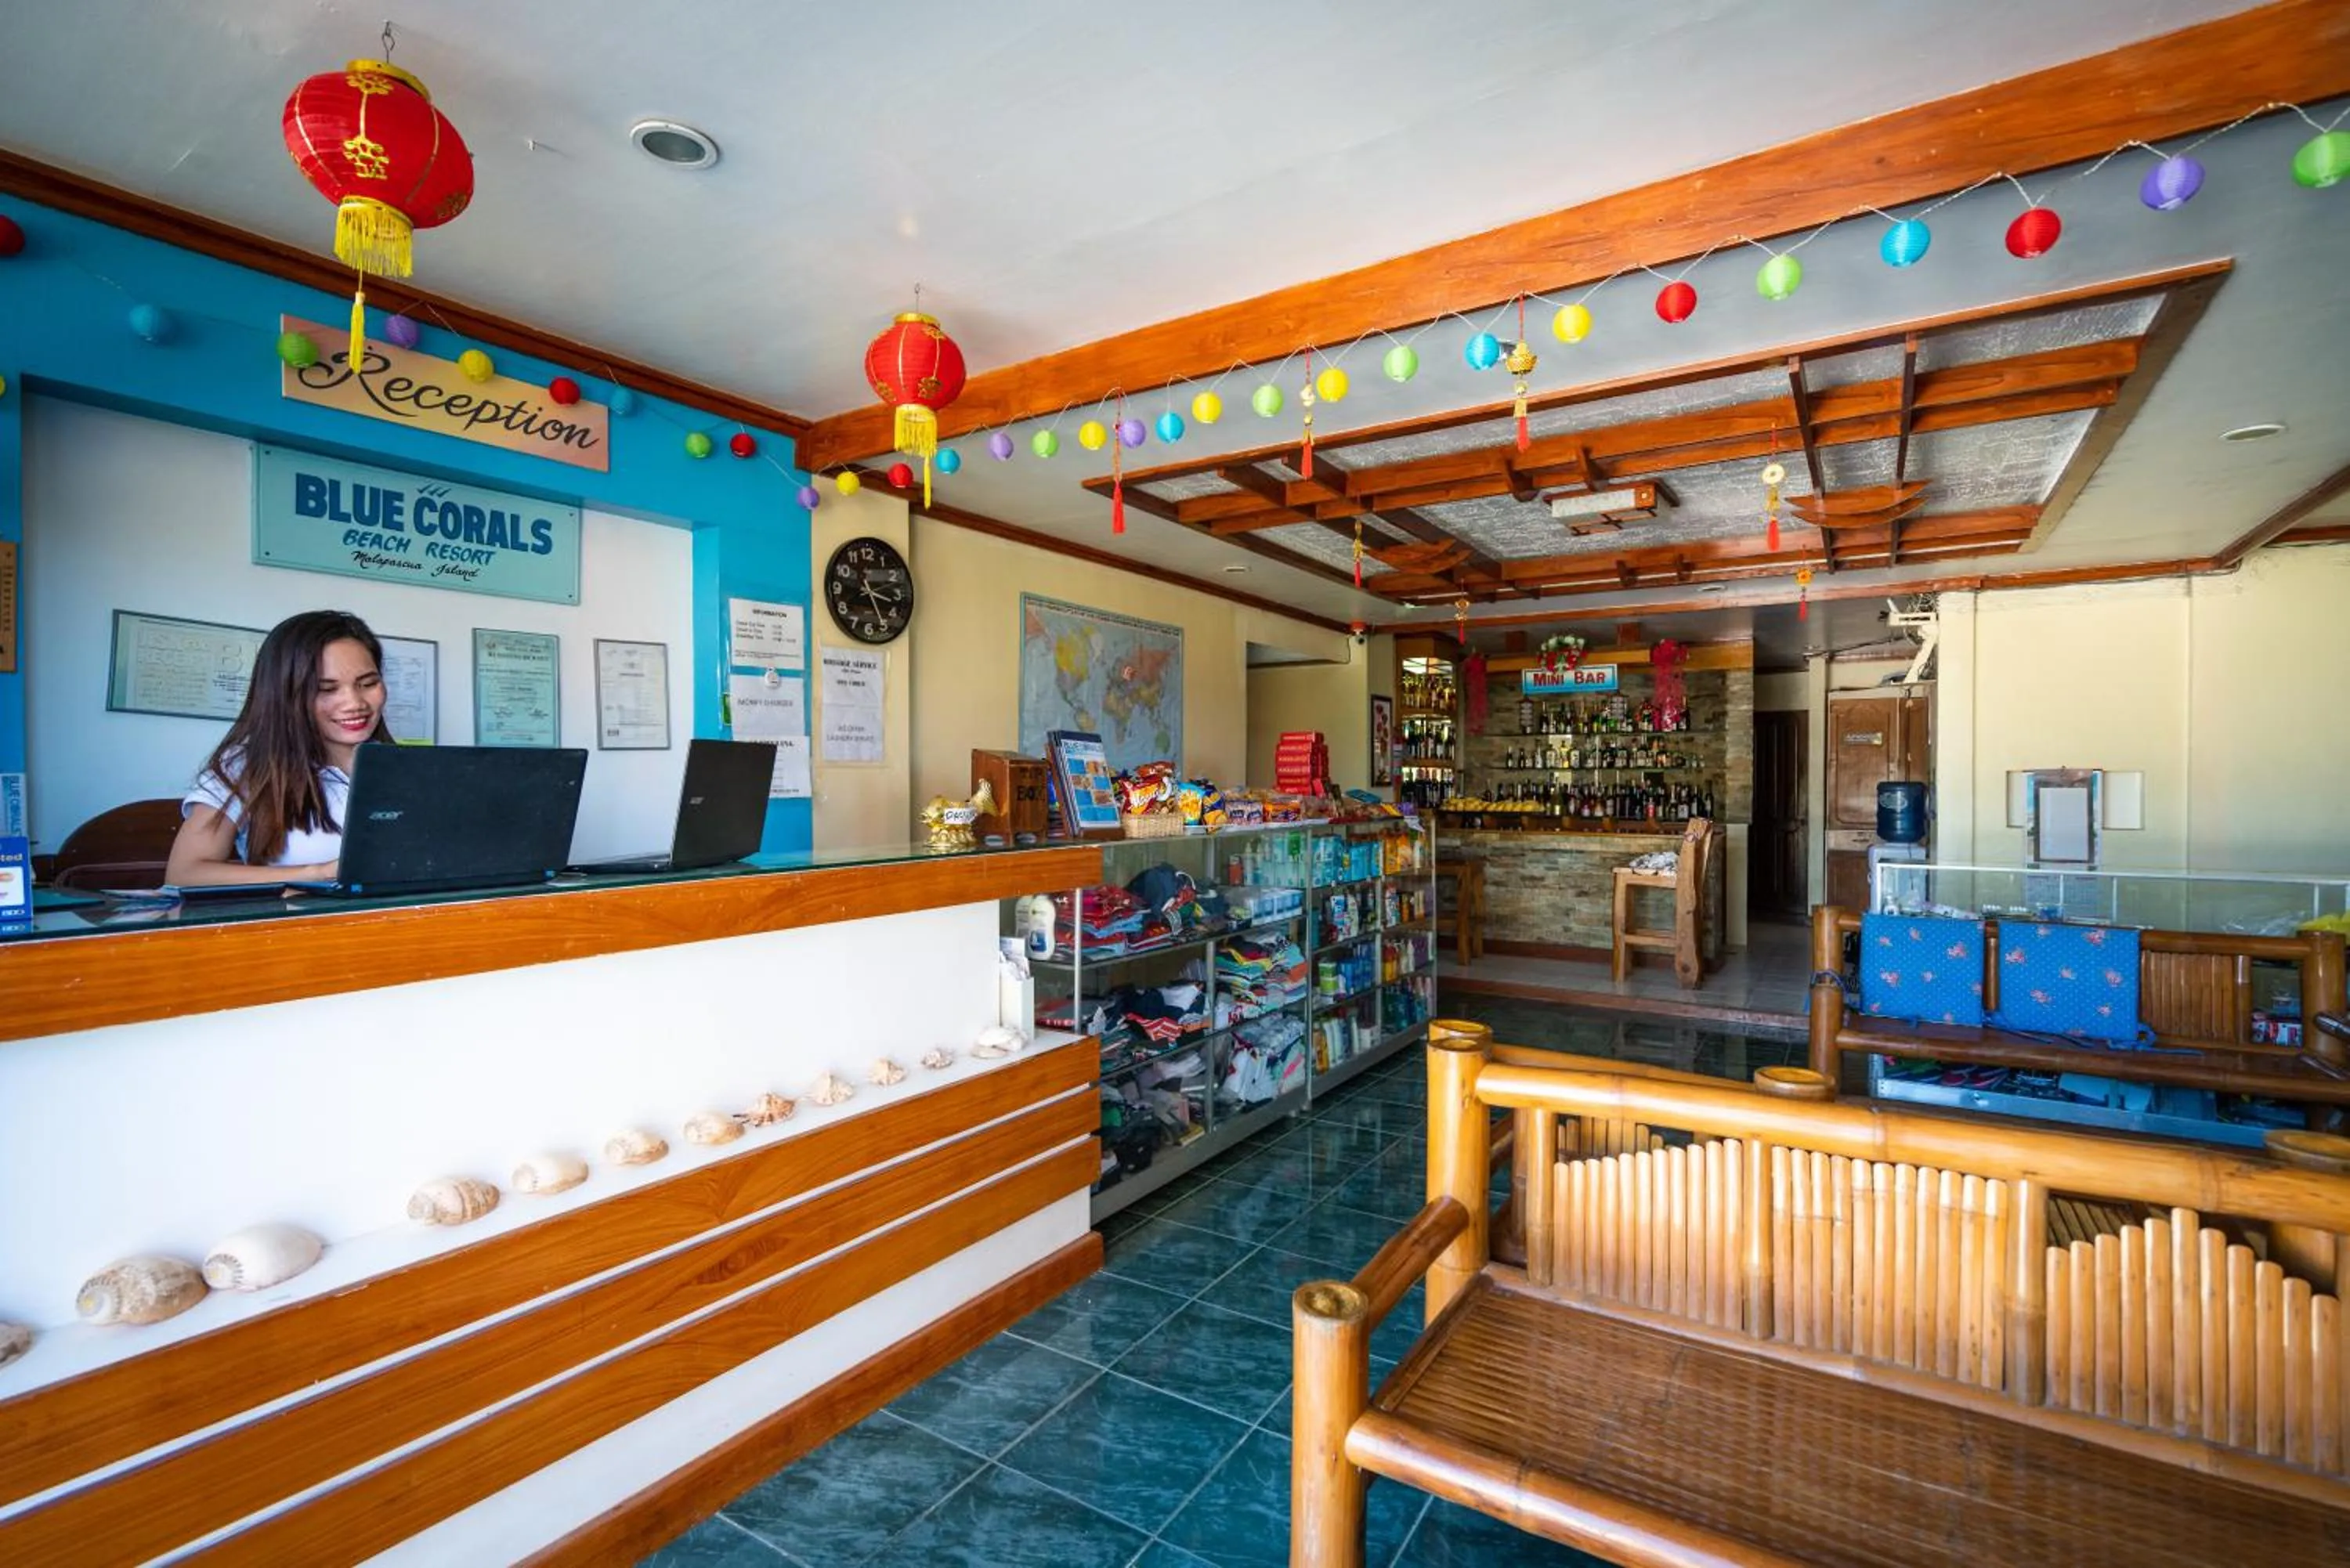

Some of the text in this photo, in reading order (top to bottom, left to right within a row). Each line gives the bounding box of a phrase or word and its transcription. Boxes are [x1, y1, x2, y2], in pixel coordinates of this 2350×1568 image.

[298, 346, 598, 450] Reception
[295, 472, 553, 555] BLUE CORALS
[342, 529, 497, 566] BEACH RESORT
[860, 547, 874, 561] 12
[848, 551, 858, 563] 11
[351, 550, 481, 581] Malapascua Island
[836, 564, 850, 577] 10
[888, 569, 898, 582] 2
[833, 581, 842, 594] 9
[893, 588, 902, 601] 3
[837, 601, 848, 615] 8
[888, 607, 897, 617] 4
[848, 616, 859, 629] 7
[864, 623, 873, 635] 6
[879, 619, 888, 631] 5
[1533, 671, 1606, 687] MINI BAR
[369, 811, 403, 820] acer
